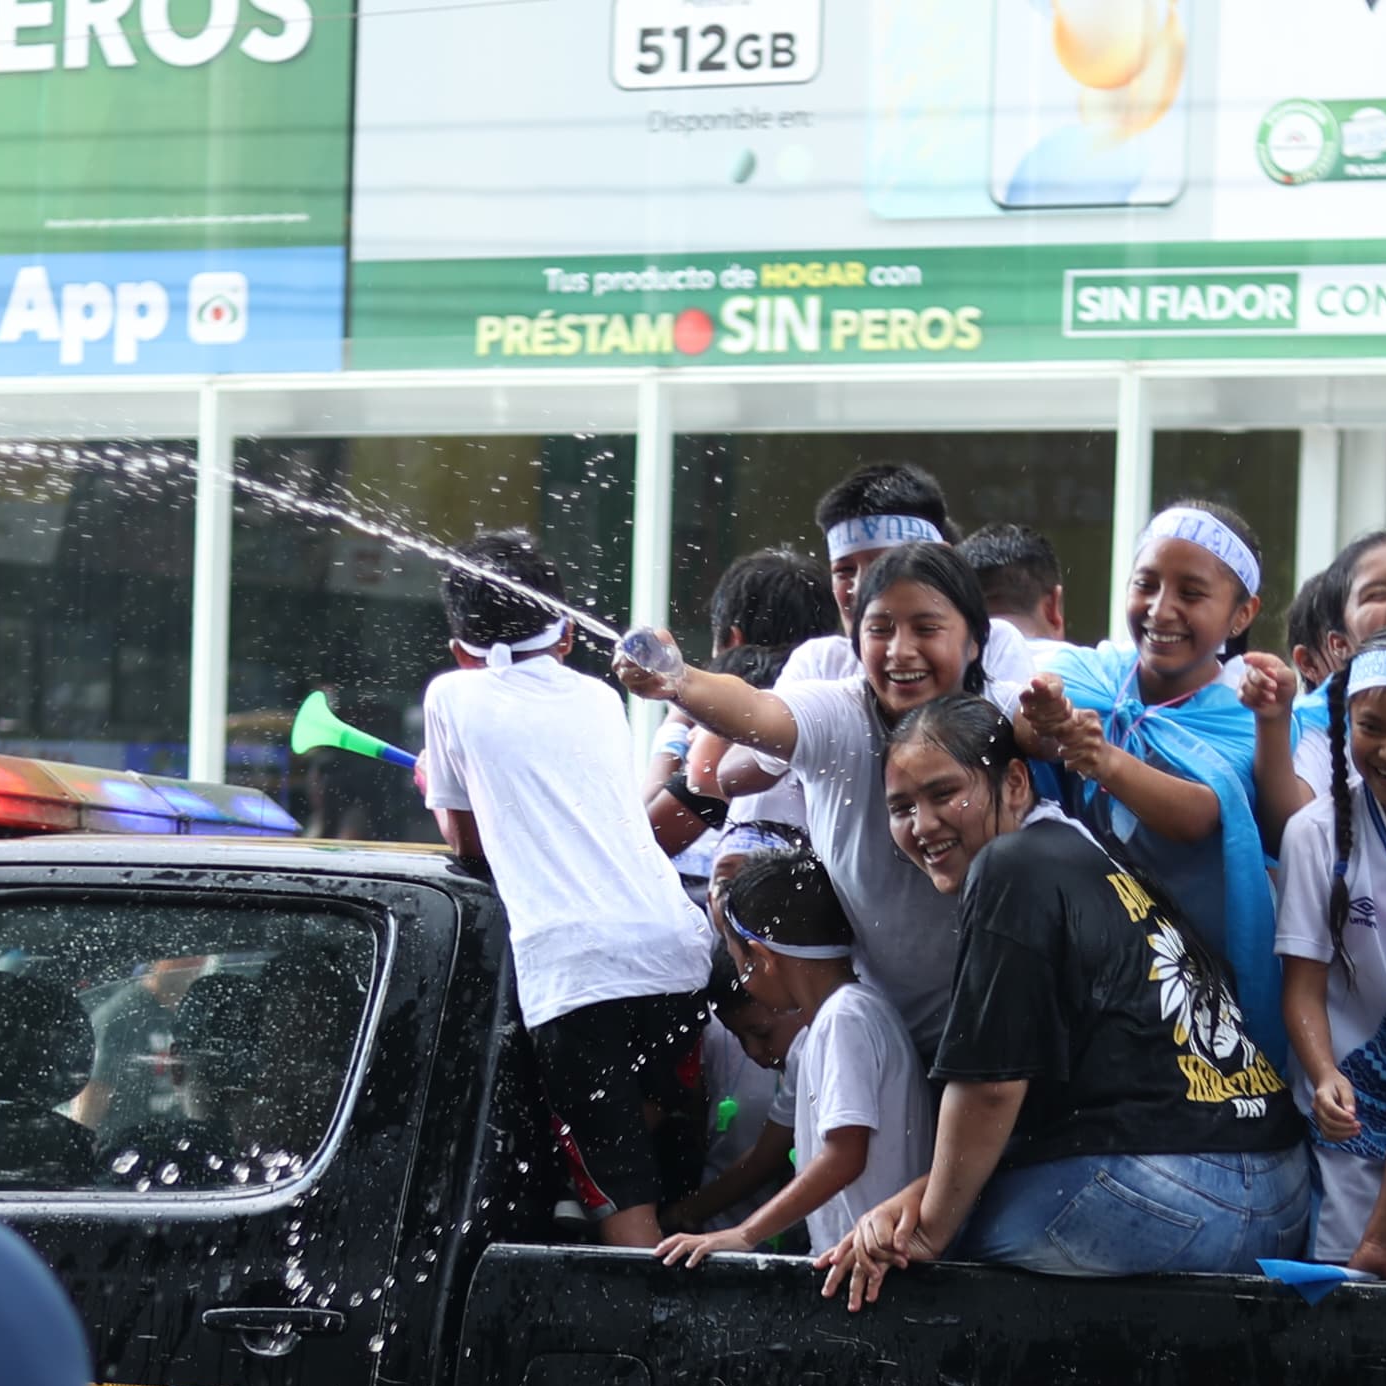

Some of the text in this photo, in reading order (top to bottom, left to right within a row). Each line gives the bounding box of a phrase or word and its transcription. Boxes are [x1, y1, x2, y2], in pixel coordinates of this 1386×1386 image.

[636, 24, 797, 74] 512GB
[647, 107, 773, 137] Disponible
[543, 262, 921, 297] Tus producto de HOGAR con
[1077, 285, 1147, 323] SIN
[1149, 282, 1292, 320] FIADOR
[719, 297, 823, 353] SIN
[830, 307, 982, 352] PEROS
[1231, 1097, 1267, 1119] DAY
